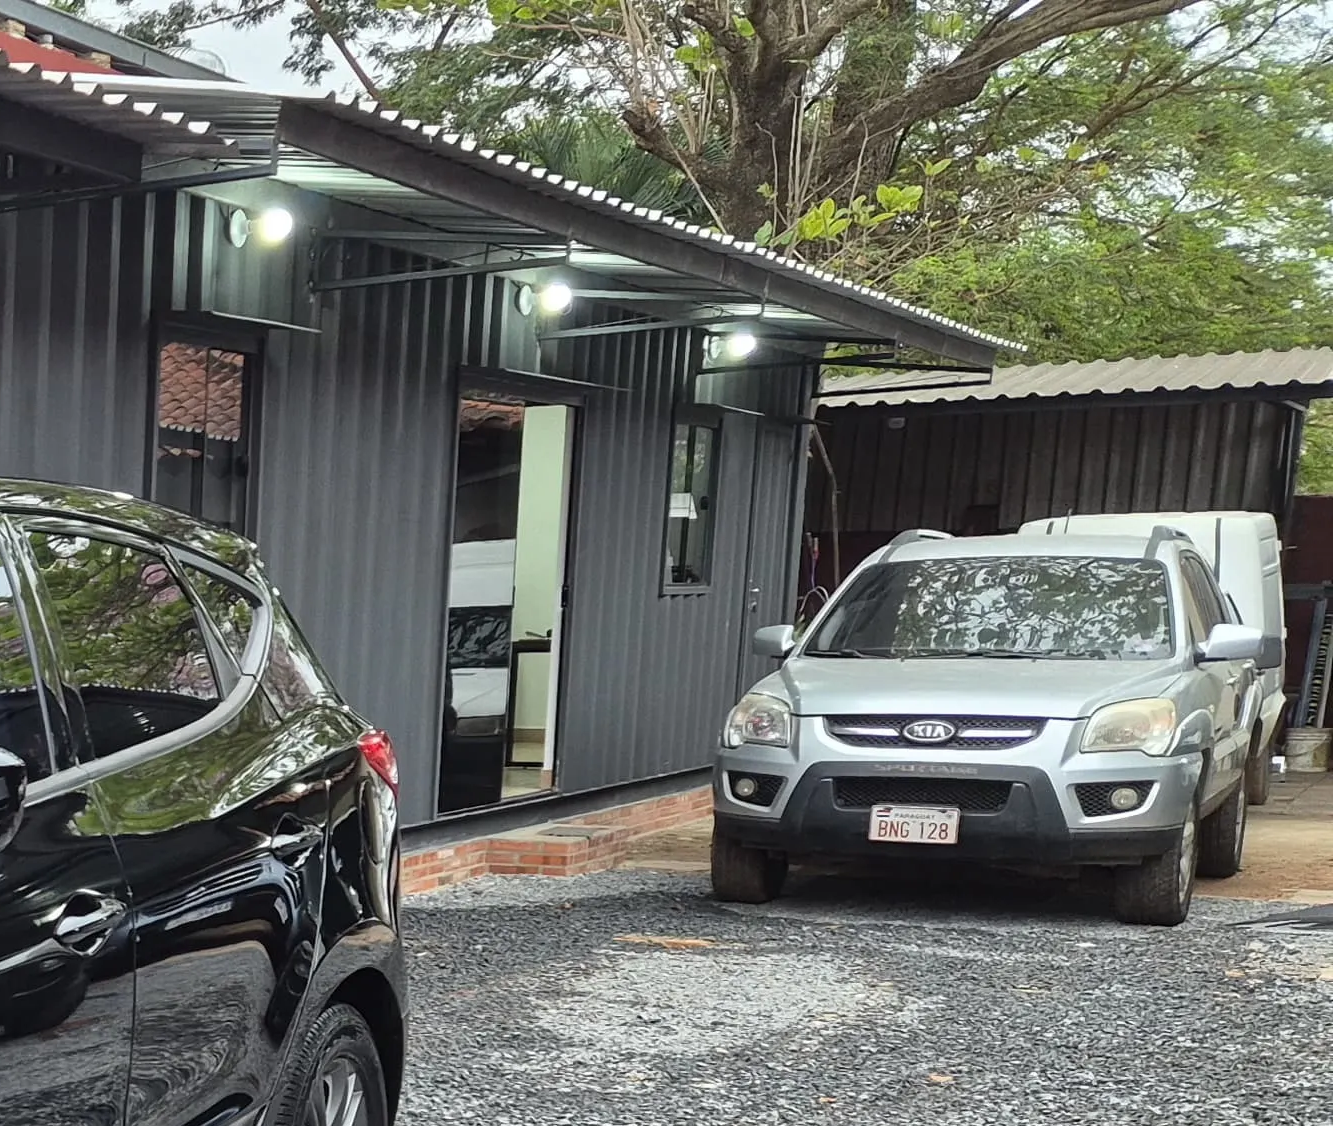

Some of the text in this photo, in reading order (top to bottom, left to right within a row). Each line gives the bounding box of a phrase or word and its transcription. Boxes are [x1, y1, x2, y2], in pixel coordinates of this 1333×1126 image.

[913, 725, 945, 737] KIA
[878, 820, 949, 840] BNG 128
